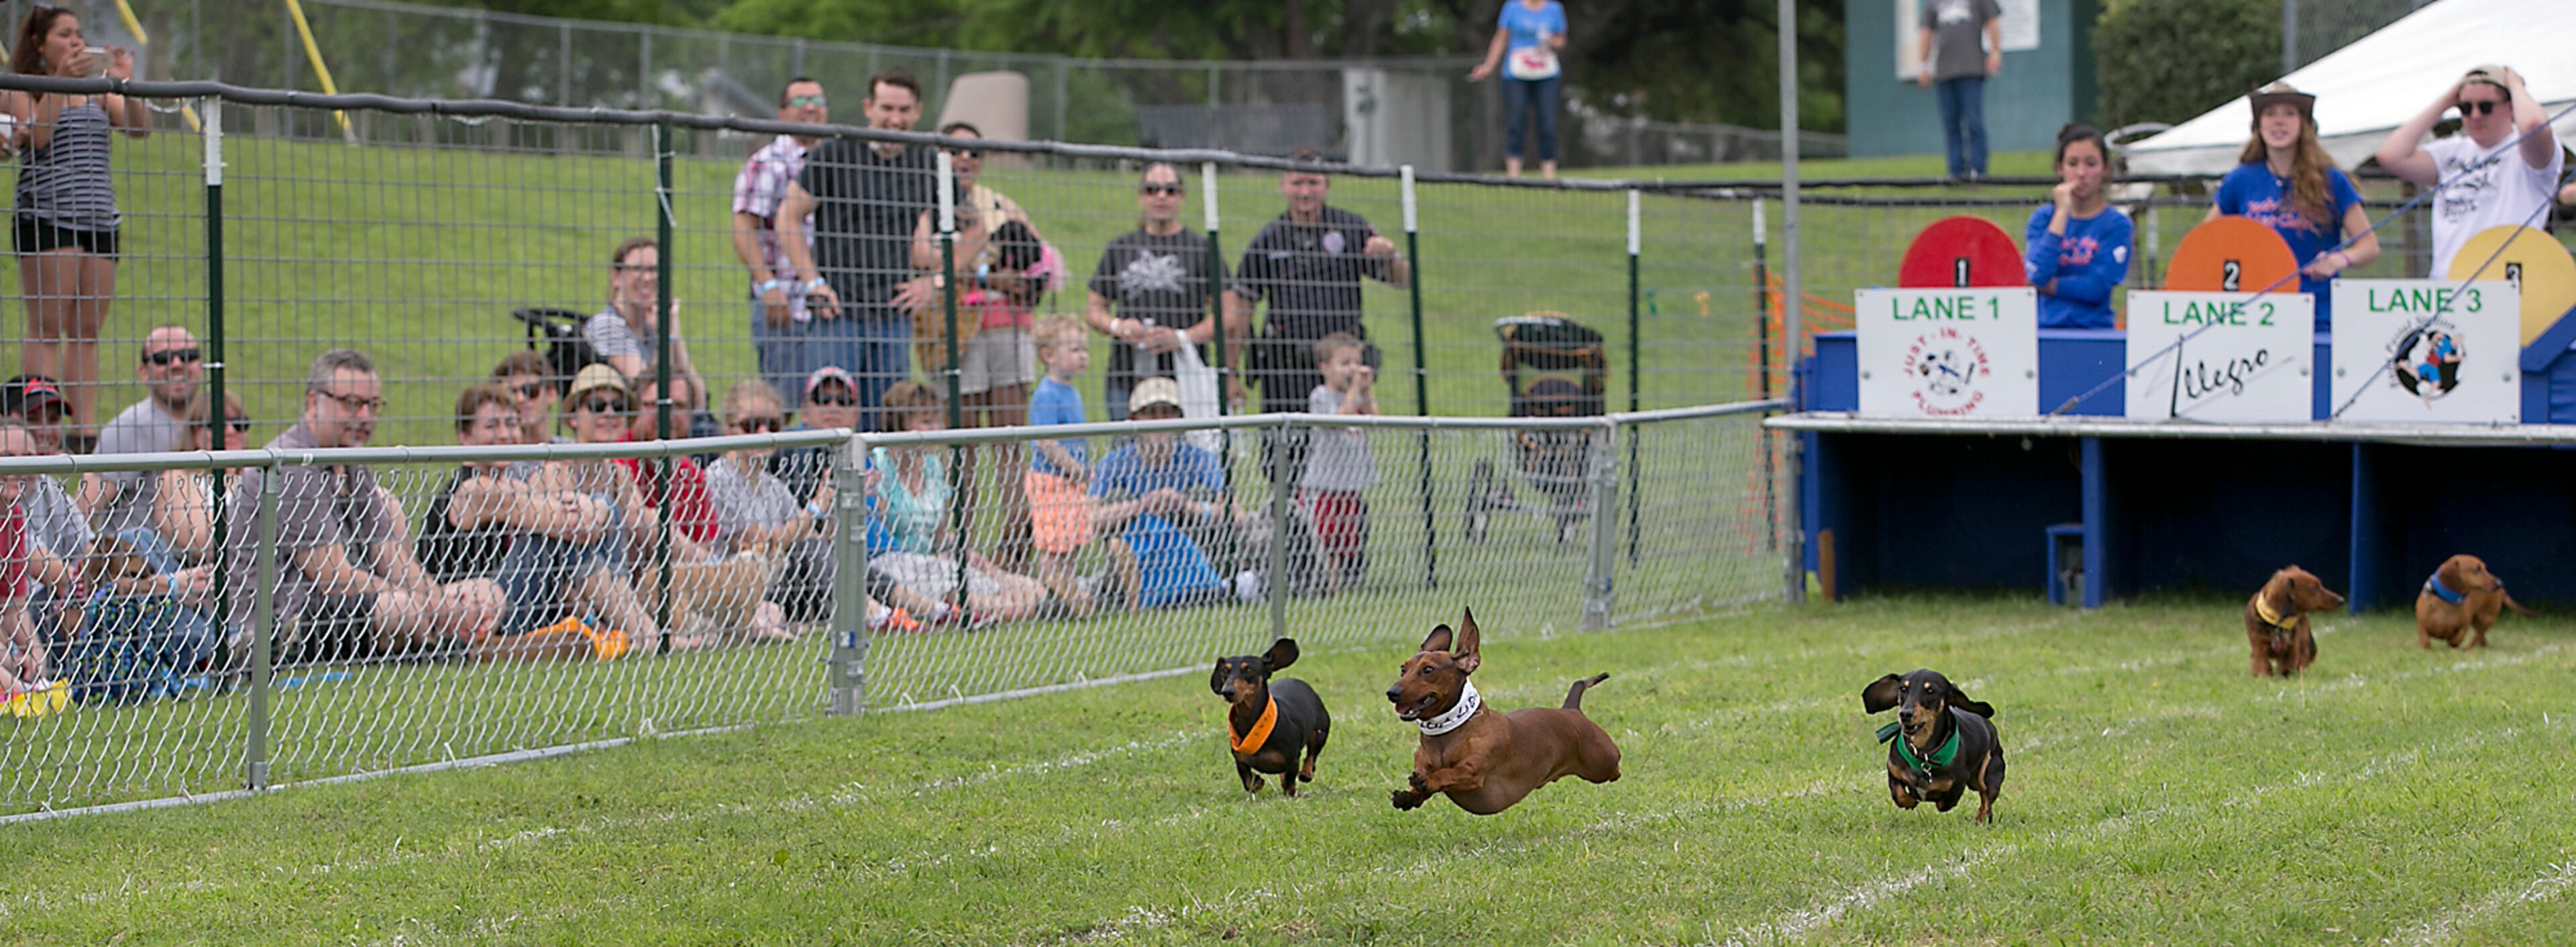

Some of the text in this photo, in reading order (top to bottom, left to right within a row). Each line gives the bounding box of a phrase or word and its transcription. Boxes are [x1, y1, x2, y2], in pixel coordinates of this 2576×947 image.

[2224, 261, 2241, 290] 2
[1891, 295, 1999, 321] LANE 1
[2163, 300, 2275, 326] LANE 2
[2368, 287, 2483, 313] LANE 3
